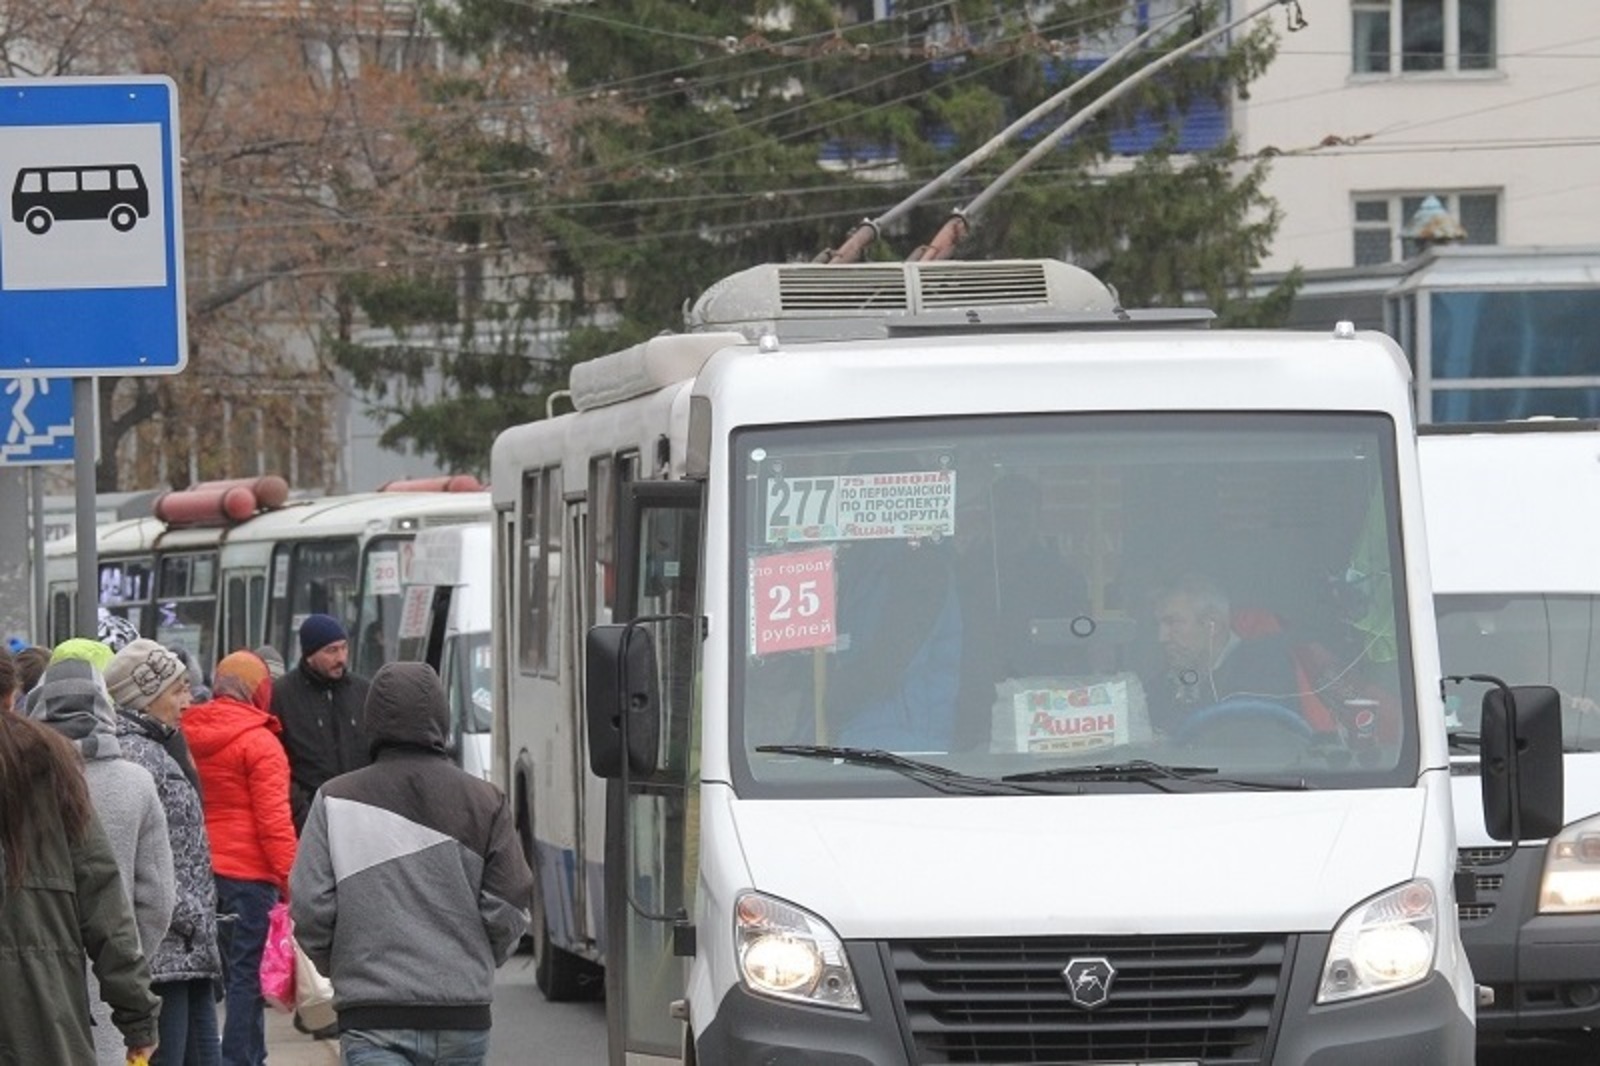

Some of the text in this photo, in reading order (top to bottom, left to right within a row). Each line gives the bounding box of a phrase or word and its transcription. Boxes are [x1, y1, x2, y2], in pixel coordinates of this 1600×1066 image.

[841, 489, 857, 499] ПО
[770, 479, 834, 526] 277
[841, 497, 950, 512] ПО ПРОСПЕКТУ
[854, 509, 949, 524] ПО ЦЮРУПА
[842, 523, 895, 536] Ашан
[375, 567, 395, 580] 20
[779, 560, 832, 575] городу
[768, 580, 820, 620] 25
[762, 619, 831, 643] рублей
[1028, 711, 1115, 737] Ашан
